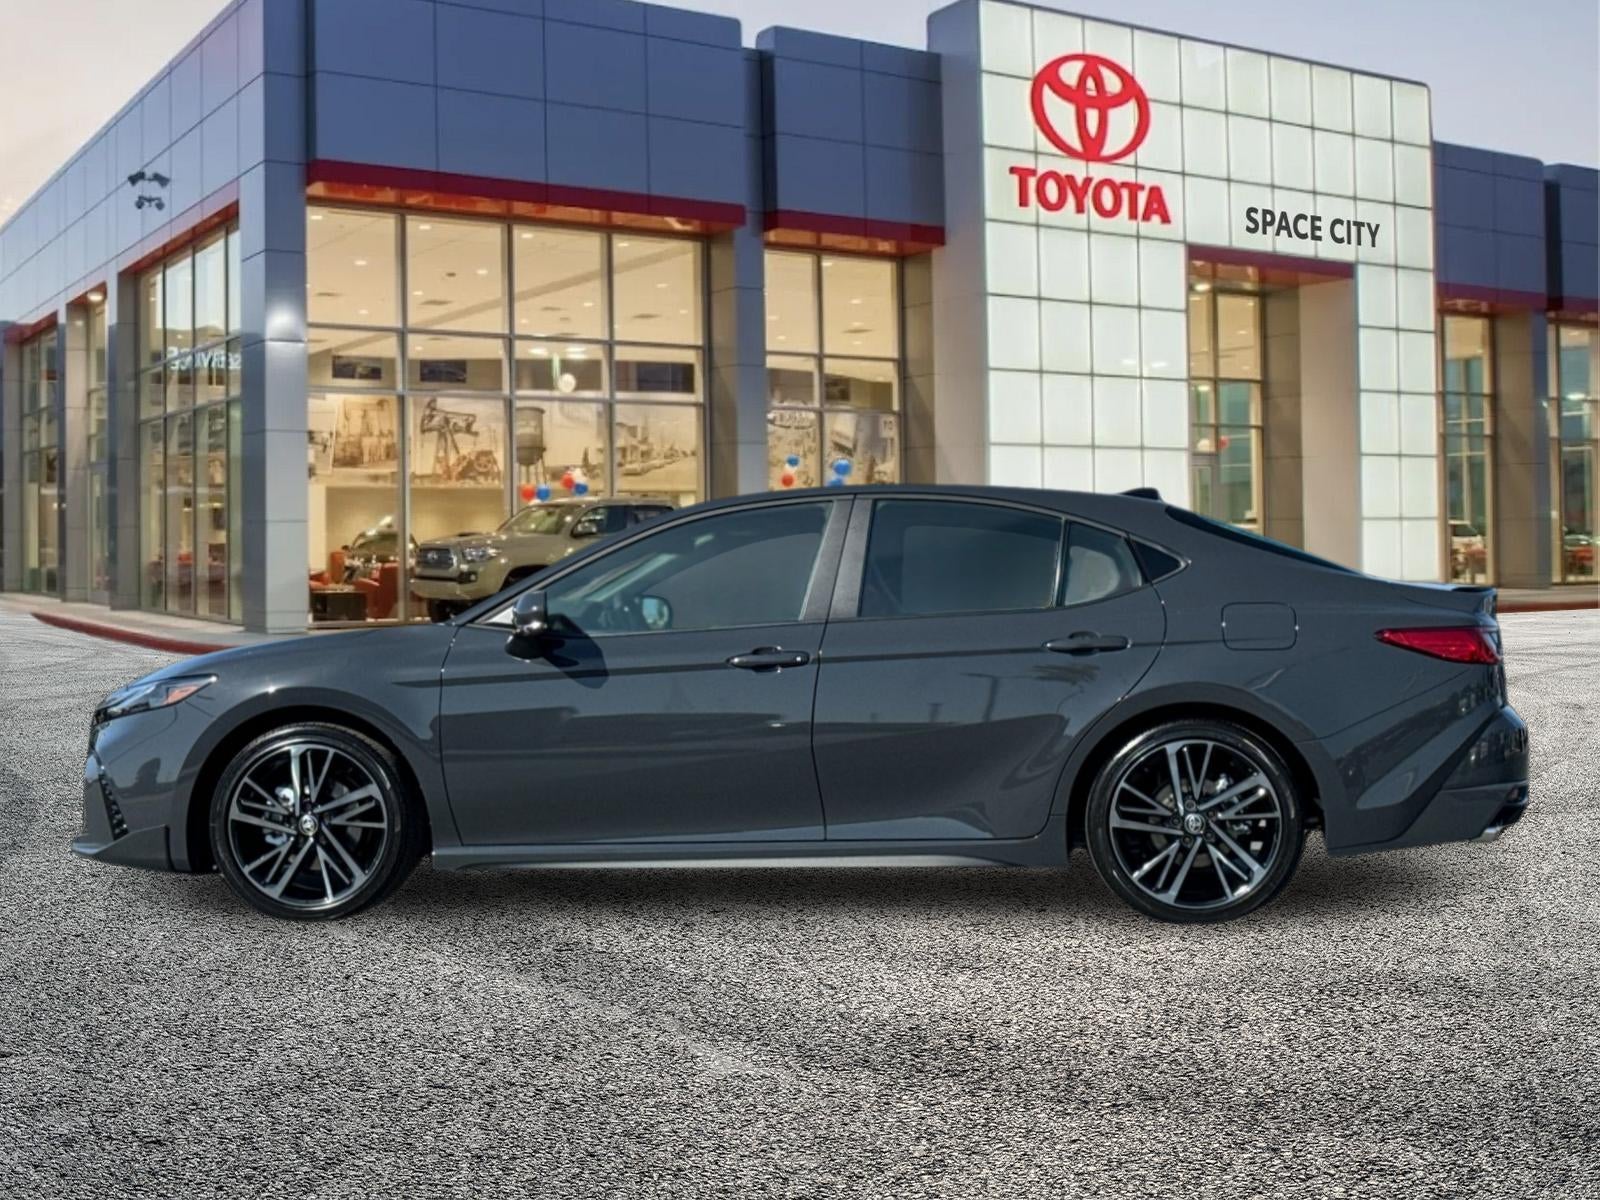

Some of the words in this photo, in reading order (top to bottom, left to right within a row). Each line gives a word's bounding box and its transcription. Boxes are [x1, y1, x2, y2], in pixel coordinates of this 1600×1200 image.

[1010, 166, 1171, 225] TOYOTA
[1245, 206, 1323, 242] SPACE
[1329, 218, 1381, 248] CITY
